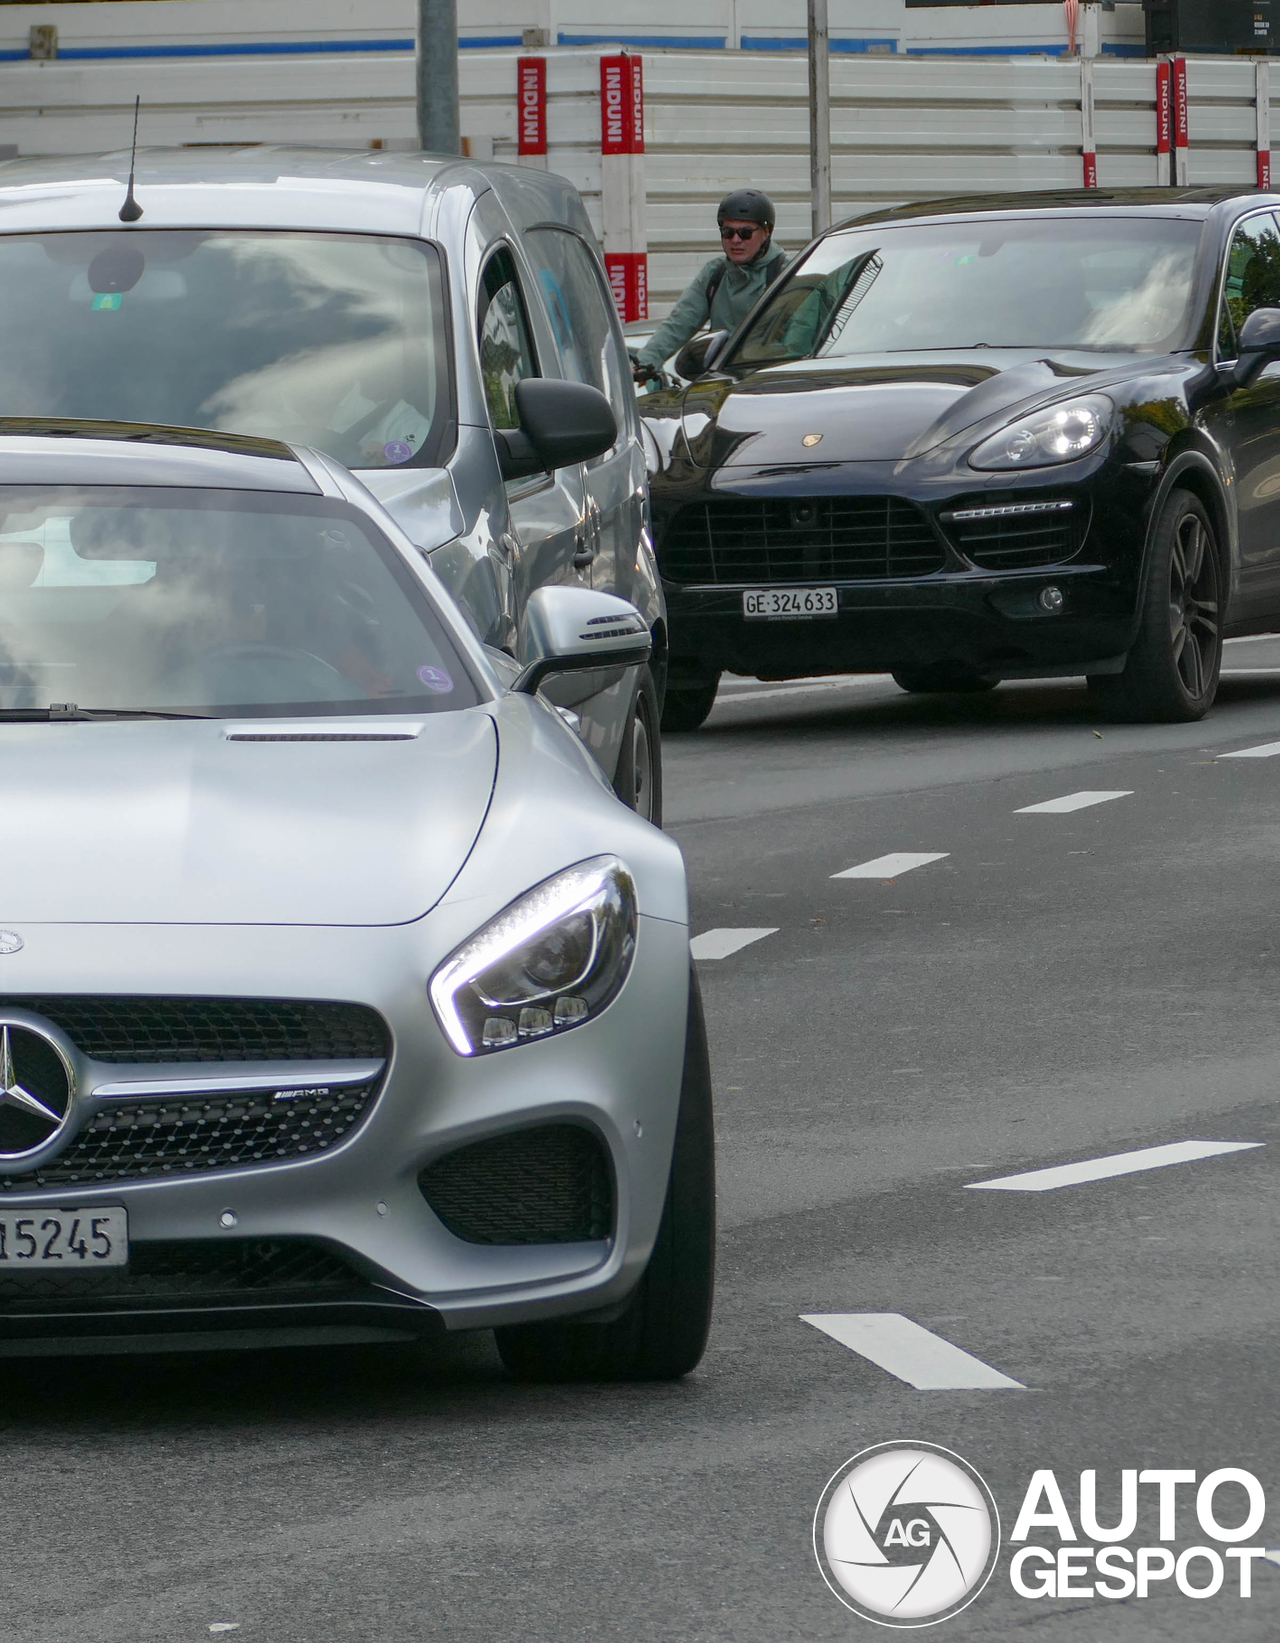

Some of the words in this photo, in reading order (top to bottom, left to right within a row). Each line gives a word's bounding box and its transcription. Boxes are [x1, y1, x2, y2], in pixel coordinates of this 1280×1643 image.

[523, 69, 539, 143] INDUNI
[606, 67, 623, 143] INDUNI
[633, 66, 643, 141] INDUNI
[1179, 74, 1187, 133] INDUNI
[610, 265, 626, 324] INDU
[747, 594, 766, 613] GE
[292, 1087, 330, 1098] AMG
